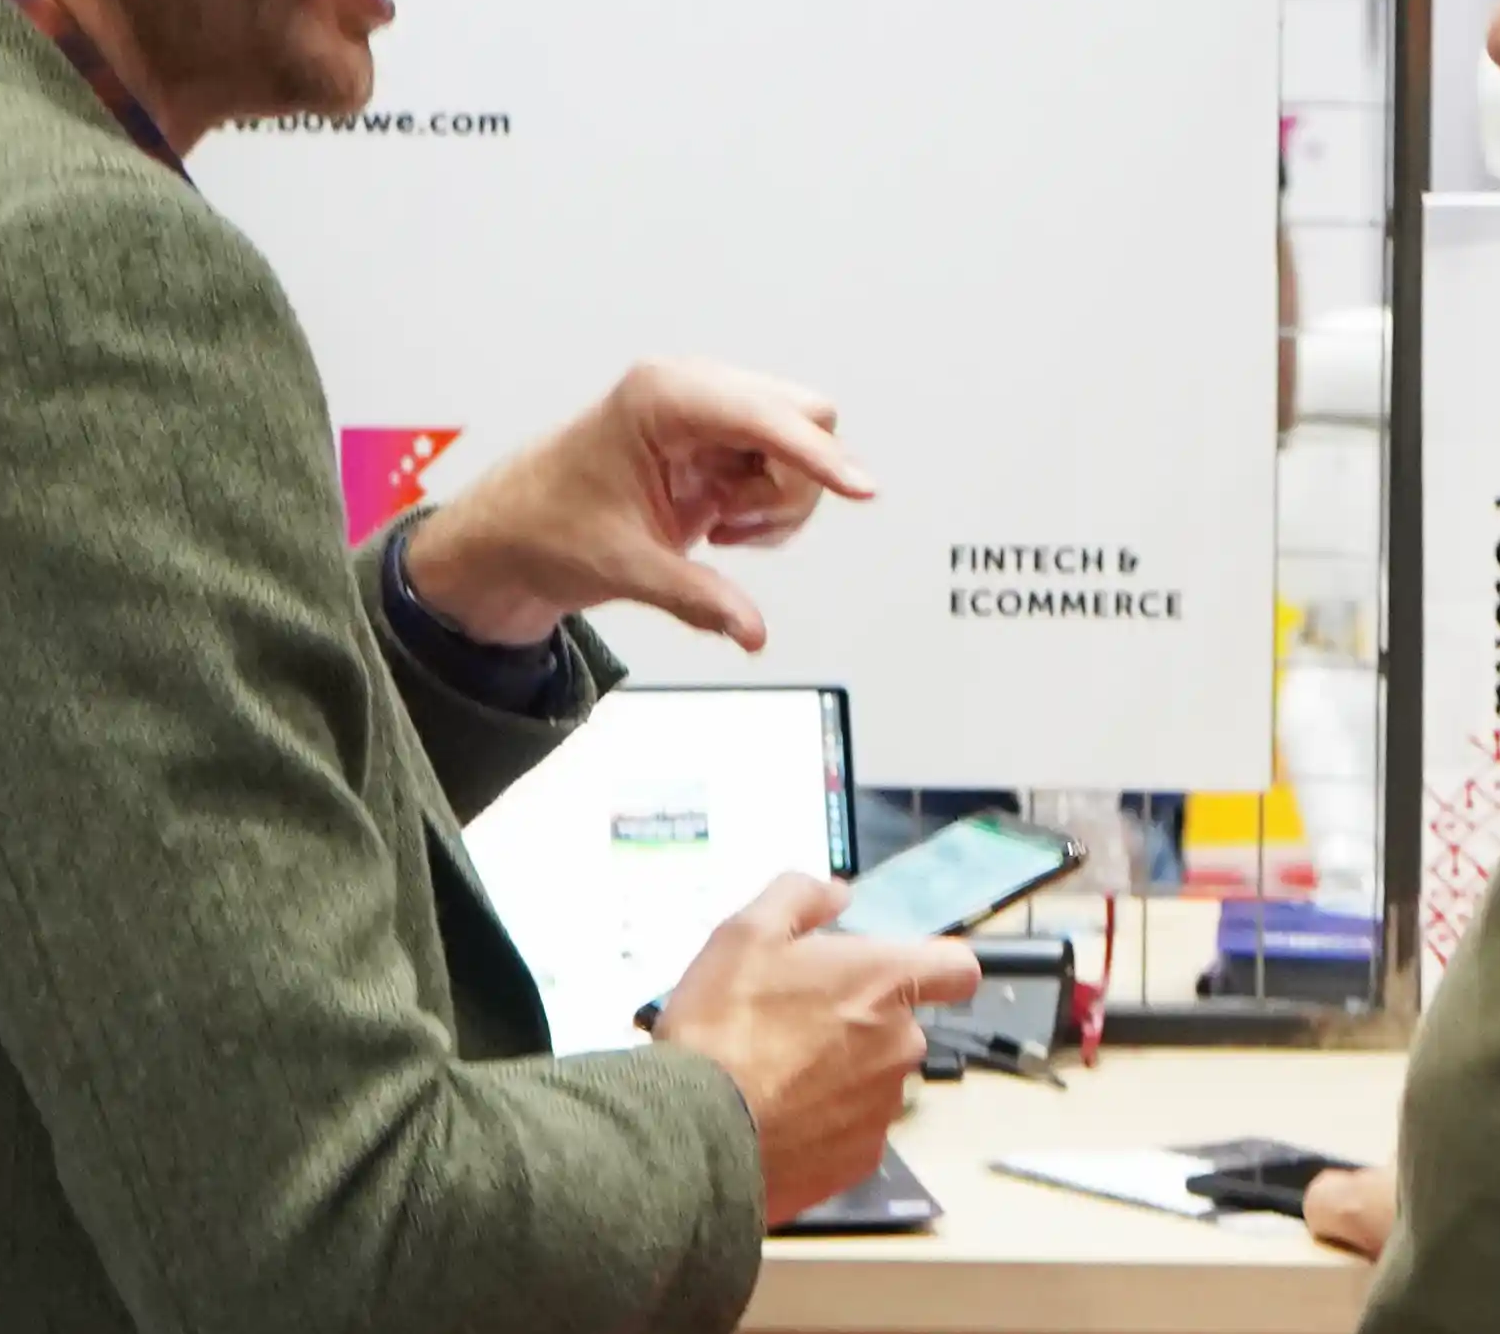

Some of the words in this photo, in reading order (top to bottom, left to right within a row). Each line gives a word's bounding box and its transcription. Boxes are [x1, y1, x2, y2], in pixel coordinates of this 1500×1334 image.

[218, 110, 512, 134] w.bowwe.com
[950, 546, 1104, 574] FINTECH
[1117, 547, 1139, 574] &
[950, 589, 1182, 618] ECOMMERCE
